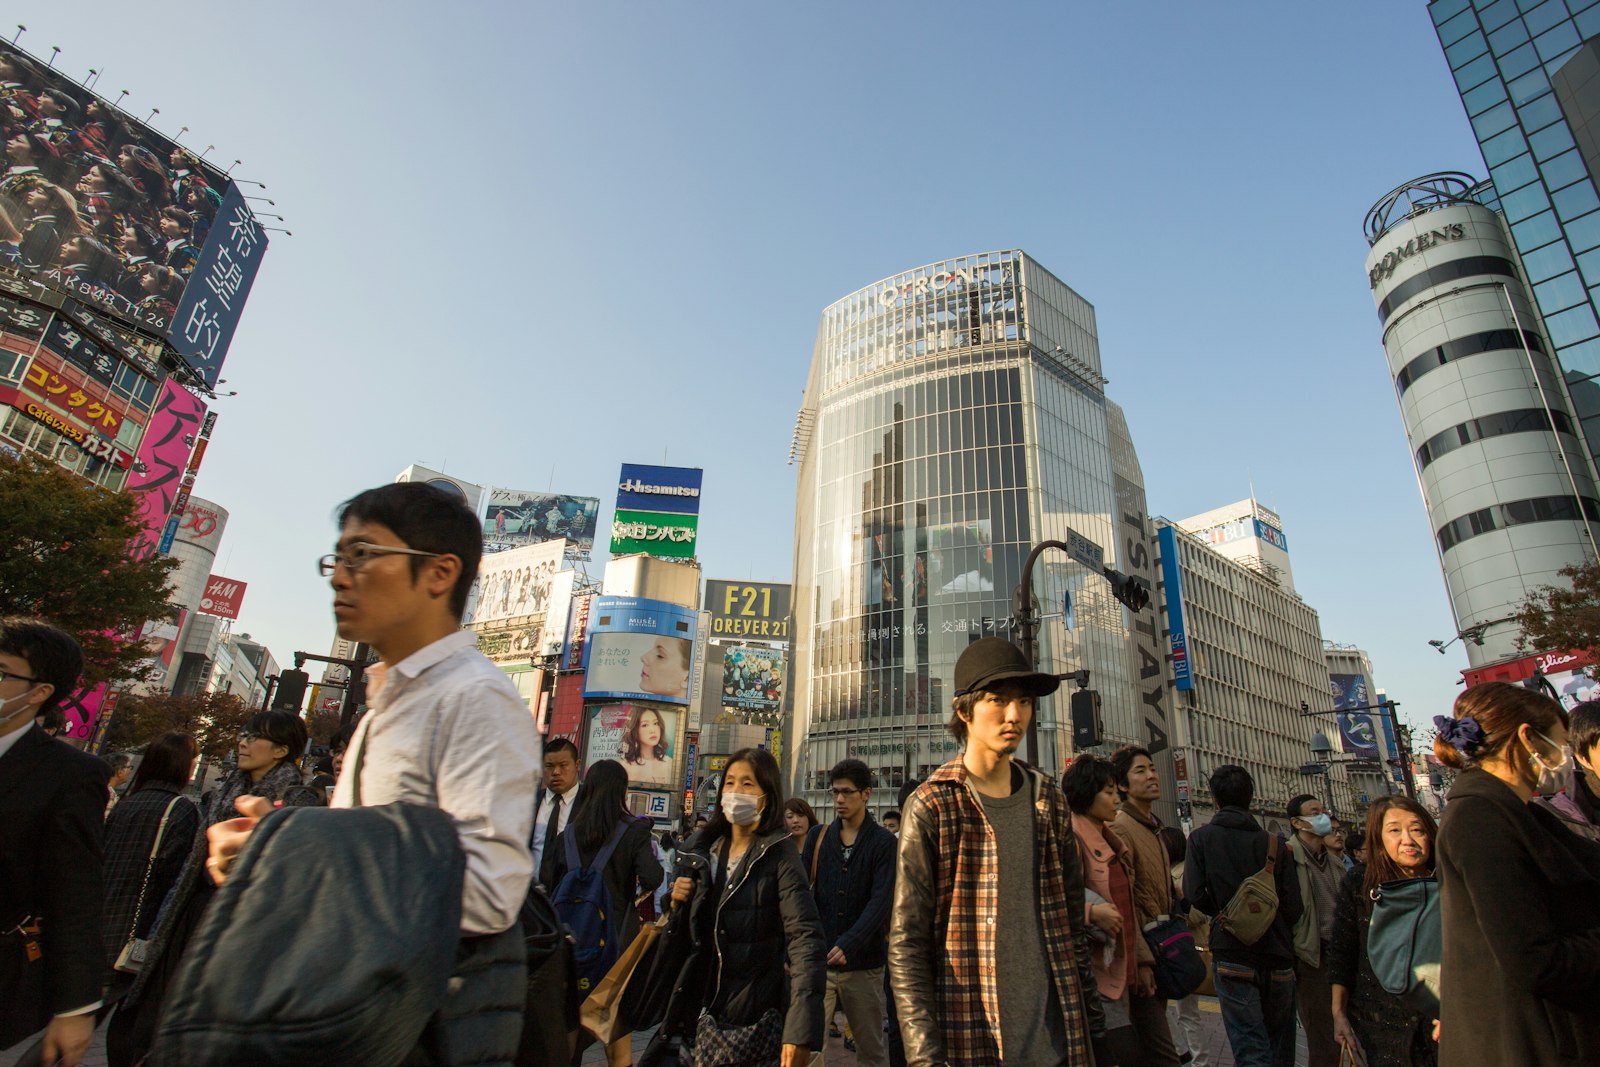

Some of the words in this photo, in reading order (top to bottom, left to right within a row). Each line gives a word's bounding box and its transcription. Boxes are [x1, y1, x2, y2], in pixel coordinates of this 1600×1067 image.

[48, 269, 116, 305] AKB48
[146, 312, 165, 329] 26
[27, 363, 118, 427] コンタクト
[82, 434, 124, 463] ガスト
[619, 479, 700, 497] Hisamitsu
[207, 580, 239, 600] H&M
[213, 604, 234, 615] 150m
[724, 585, 771, 617] F21
[771, 621, 788, 637] 21
[598, 647, 631, 656] あなたの
[1171, 632, 1188, 681] SEIBU
[1536, 654, 1578, 674] Glico
[850, 742, 921, 756] STARBUCKS
[650, 796, 666, 812] 店
